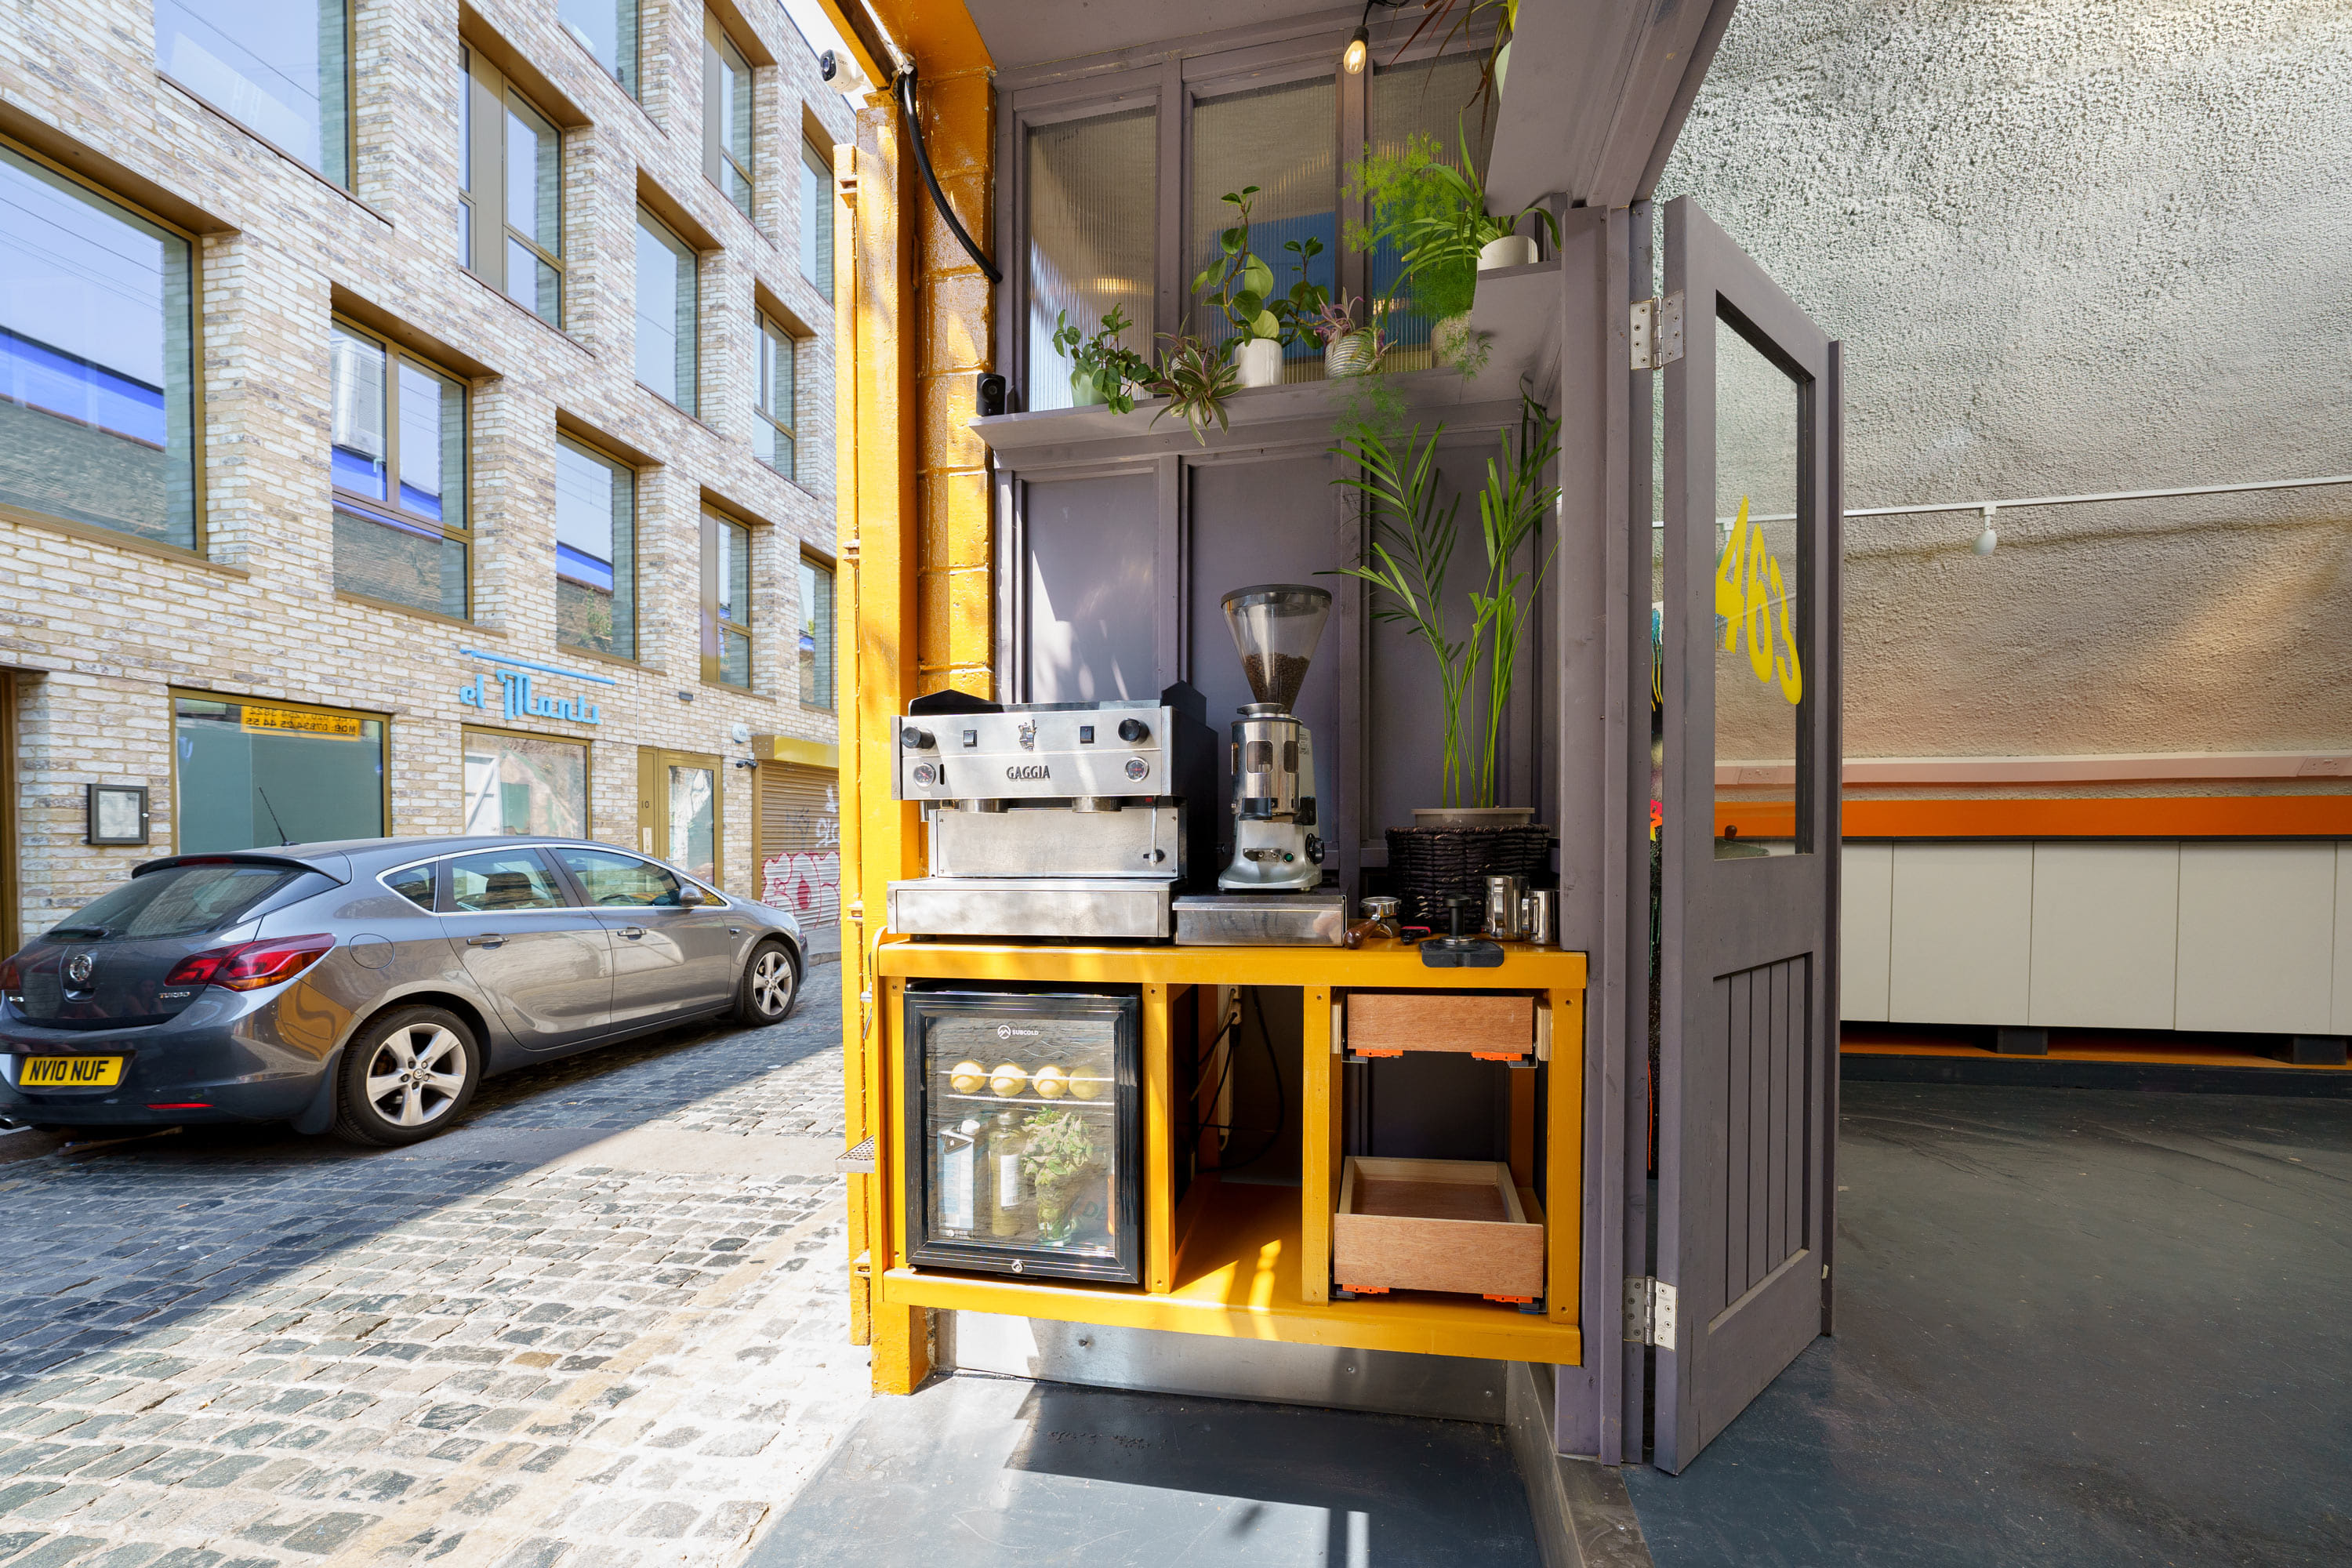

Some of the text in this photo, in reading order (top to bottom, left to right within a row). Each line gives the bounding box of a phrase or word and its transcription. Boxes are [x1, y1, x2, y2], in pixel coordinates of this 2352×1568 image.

[1715, 493, 1802, 705] 463
[459, 673, 487, 710] el
[1007, 765, 1051, 779] GAGGIA
[641, 800, 650, 809] 10
[28, 1060, 110, 1081] NV10 NUF
